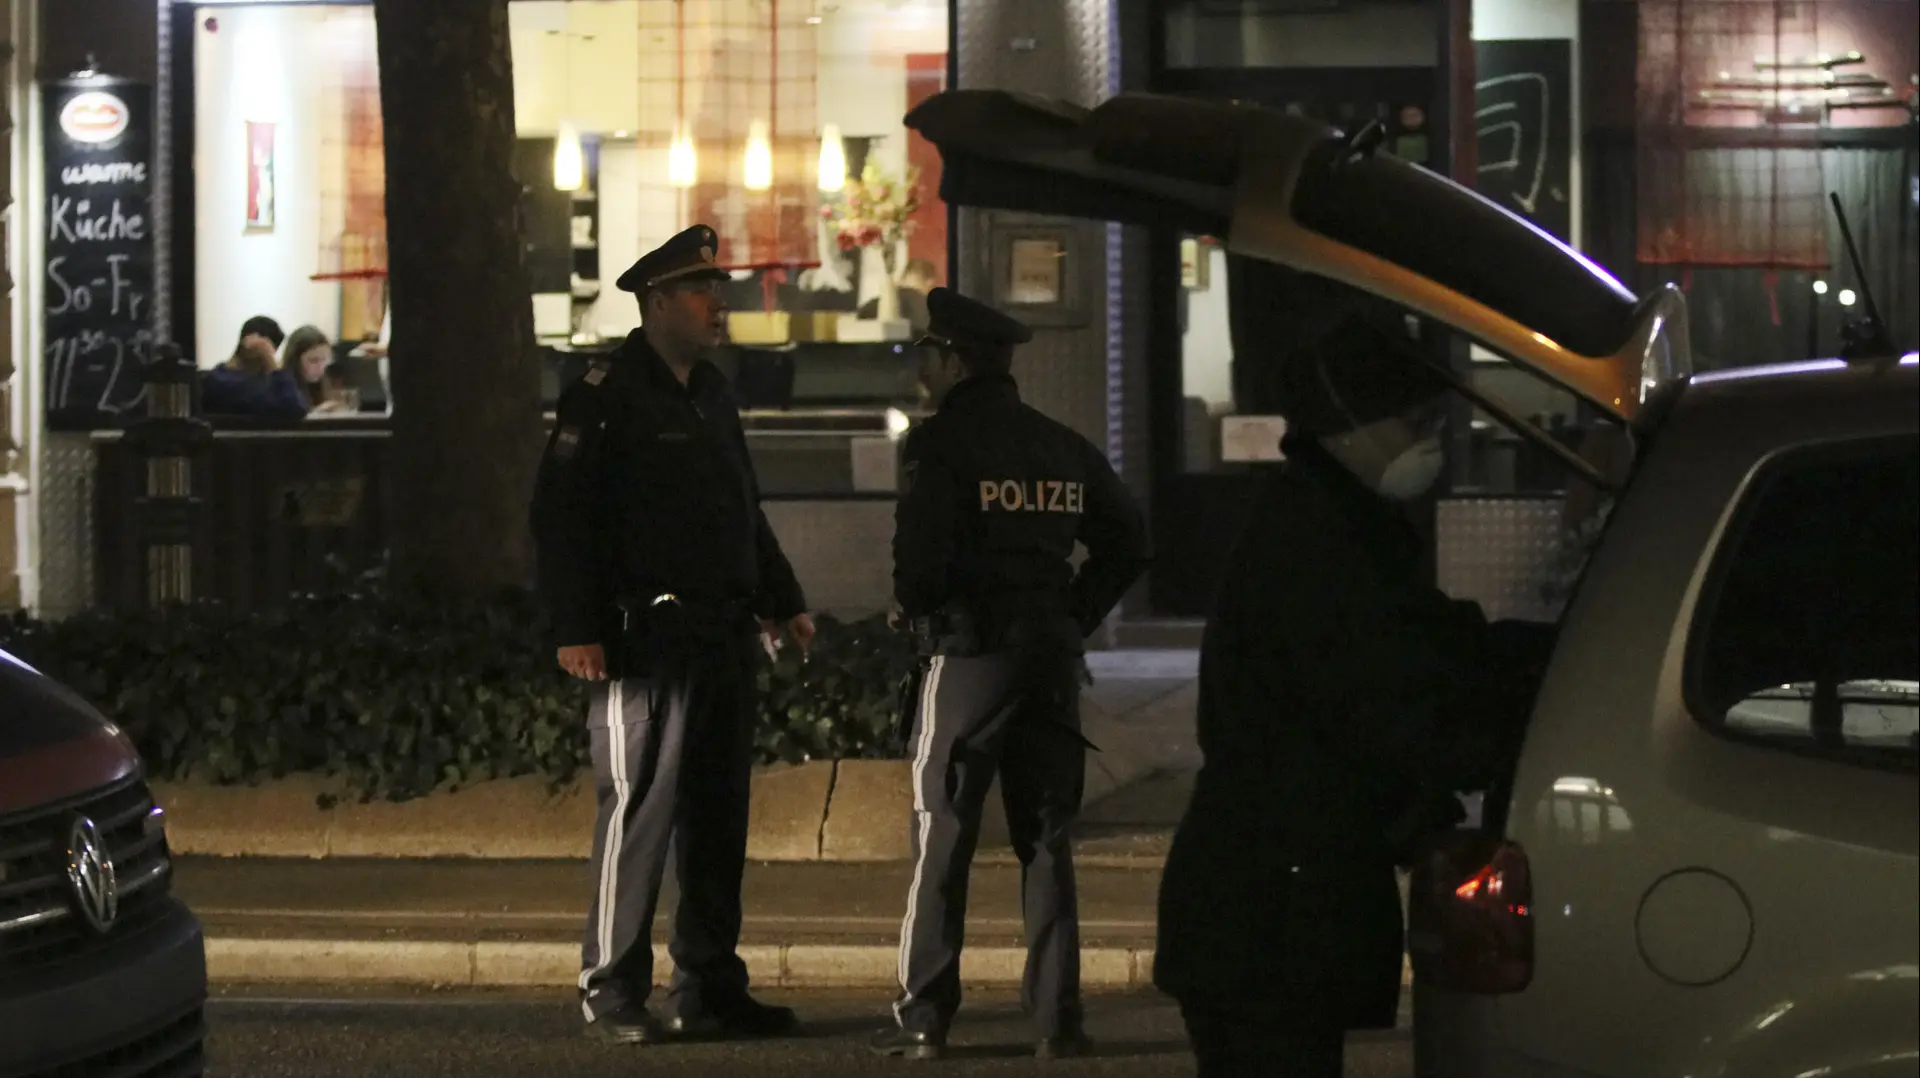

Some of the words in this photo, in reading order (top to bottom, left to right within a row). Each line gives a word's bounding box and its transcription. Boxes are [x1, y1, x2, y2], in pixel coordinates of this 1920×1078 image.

[60, 161, 148, 186] warme
[50, 193, 146, 244] Küche
[46, 253, 144, 321] So-Fr
[979, 479, 1085, 513] POLIZEI
